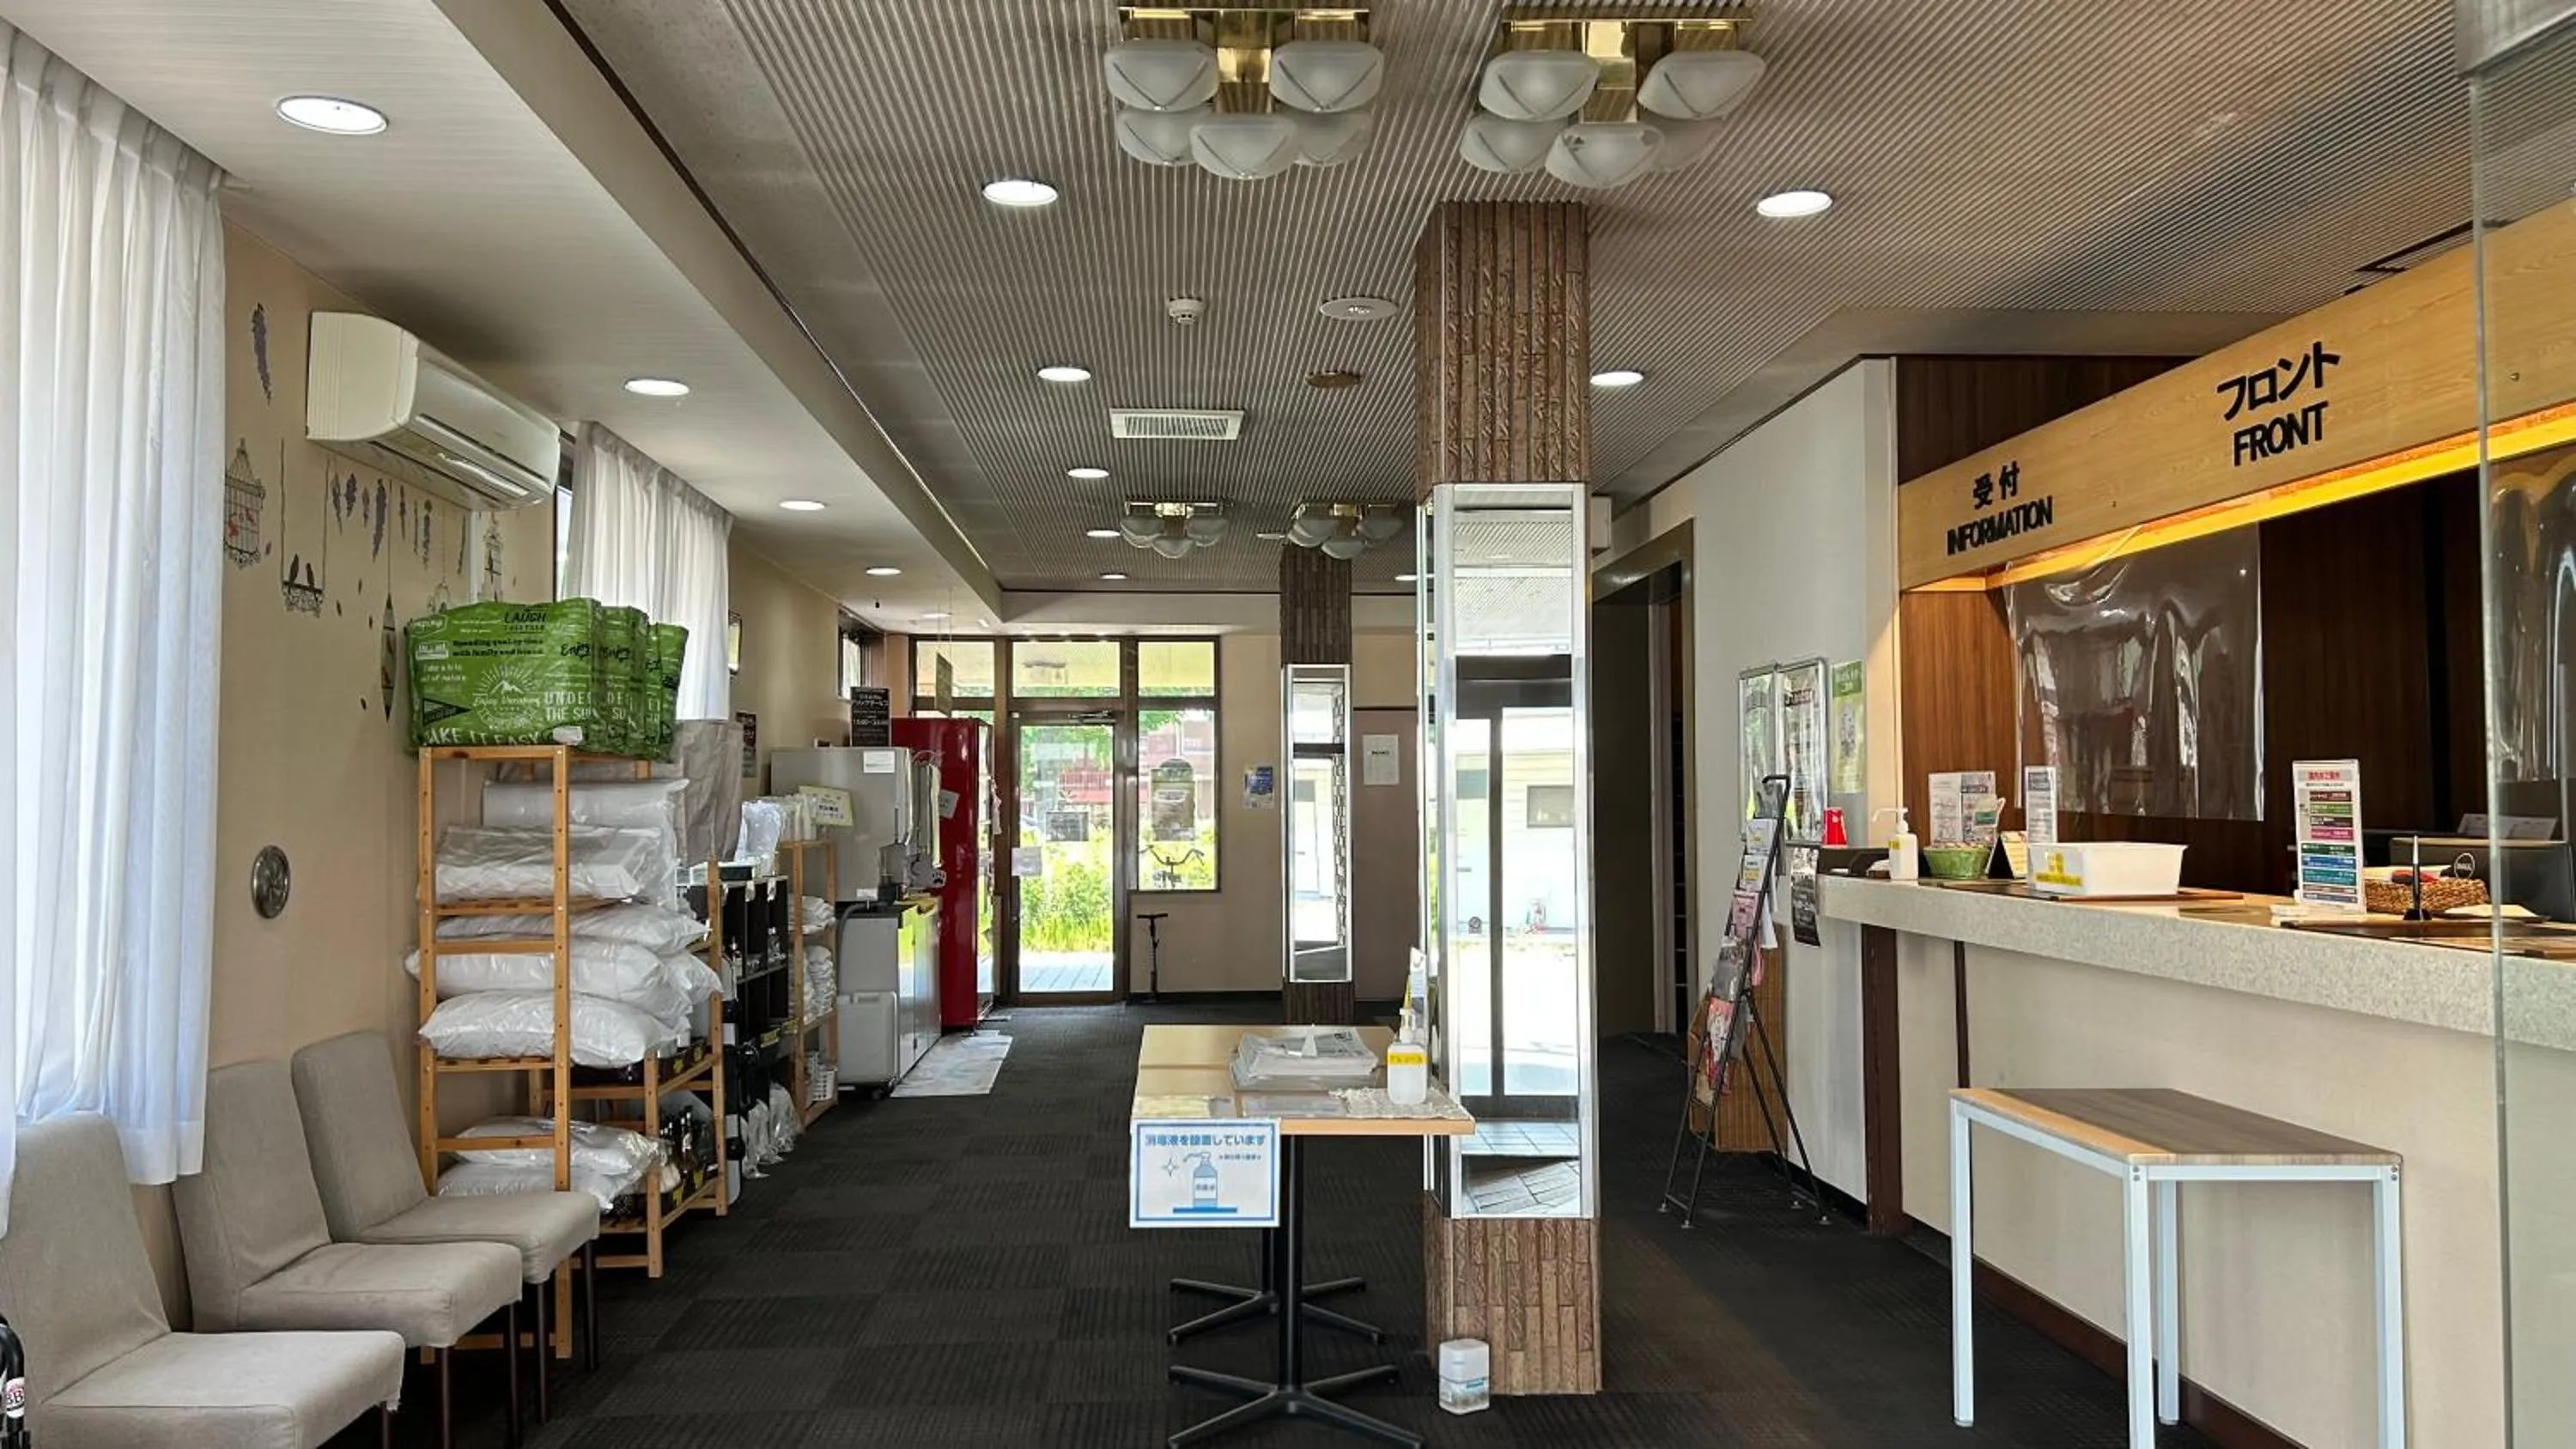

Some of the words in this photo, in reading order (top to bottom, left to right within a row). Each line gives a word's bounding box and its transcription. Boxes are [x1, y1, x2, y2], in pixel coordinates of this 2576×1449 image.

[2215, 341, 2341, 421] フロント
[2233, 400, 2329, 468] FRONT
[1972, 460, 2020, 511] 受付
[1947, 495, 2053, 557] INFORMATION
[504, 610, 547, 624] LAUGH
[545, 706, 568, 721] THE
